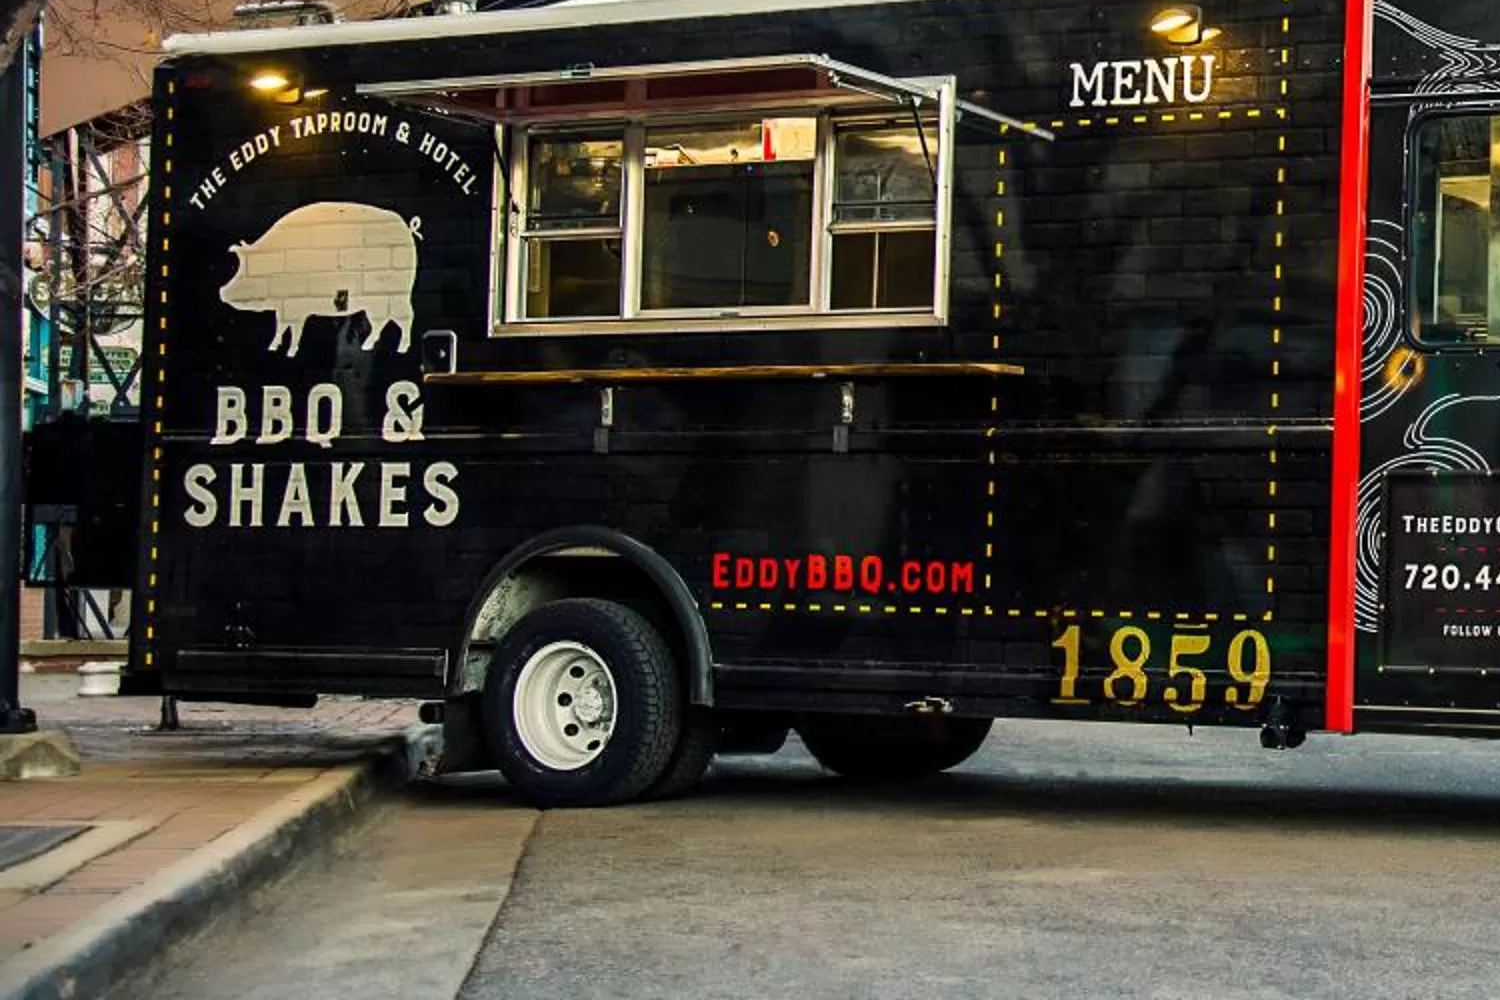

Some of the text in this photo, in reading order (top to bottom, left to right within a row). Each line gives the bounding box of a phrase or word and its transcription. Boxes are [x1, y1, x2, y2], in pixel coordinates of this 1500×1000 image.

[1069, 55, 1217, 107] MENU
[189, 110, 479, 211] THE EDDY TAPROOM & HOTEL
[209, 380, 427, 449] BBQ &
[183, 460, 461, 528] SHAKES
[1442, 623, 1493, 638] FOLLOW
[1050, 622, 1273, 714] 1859
